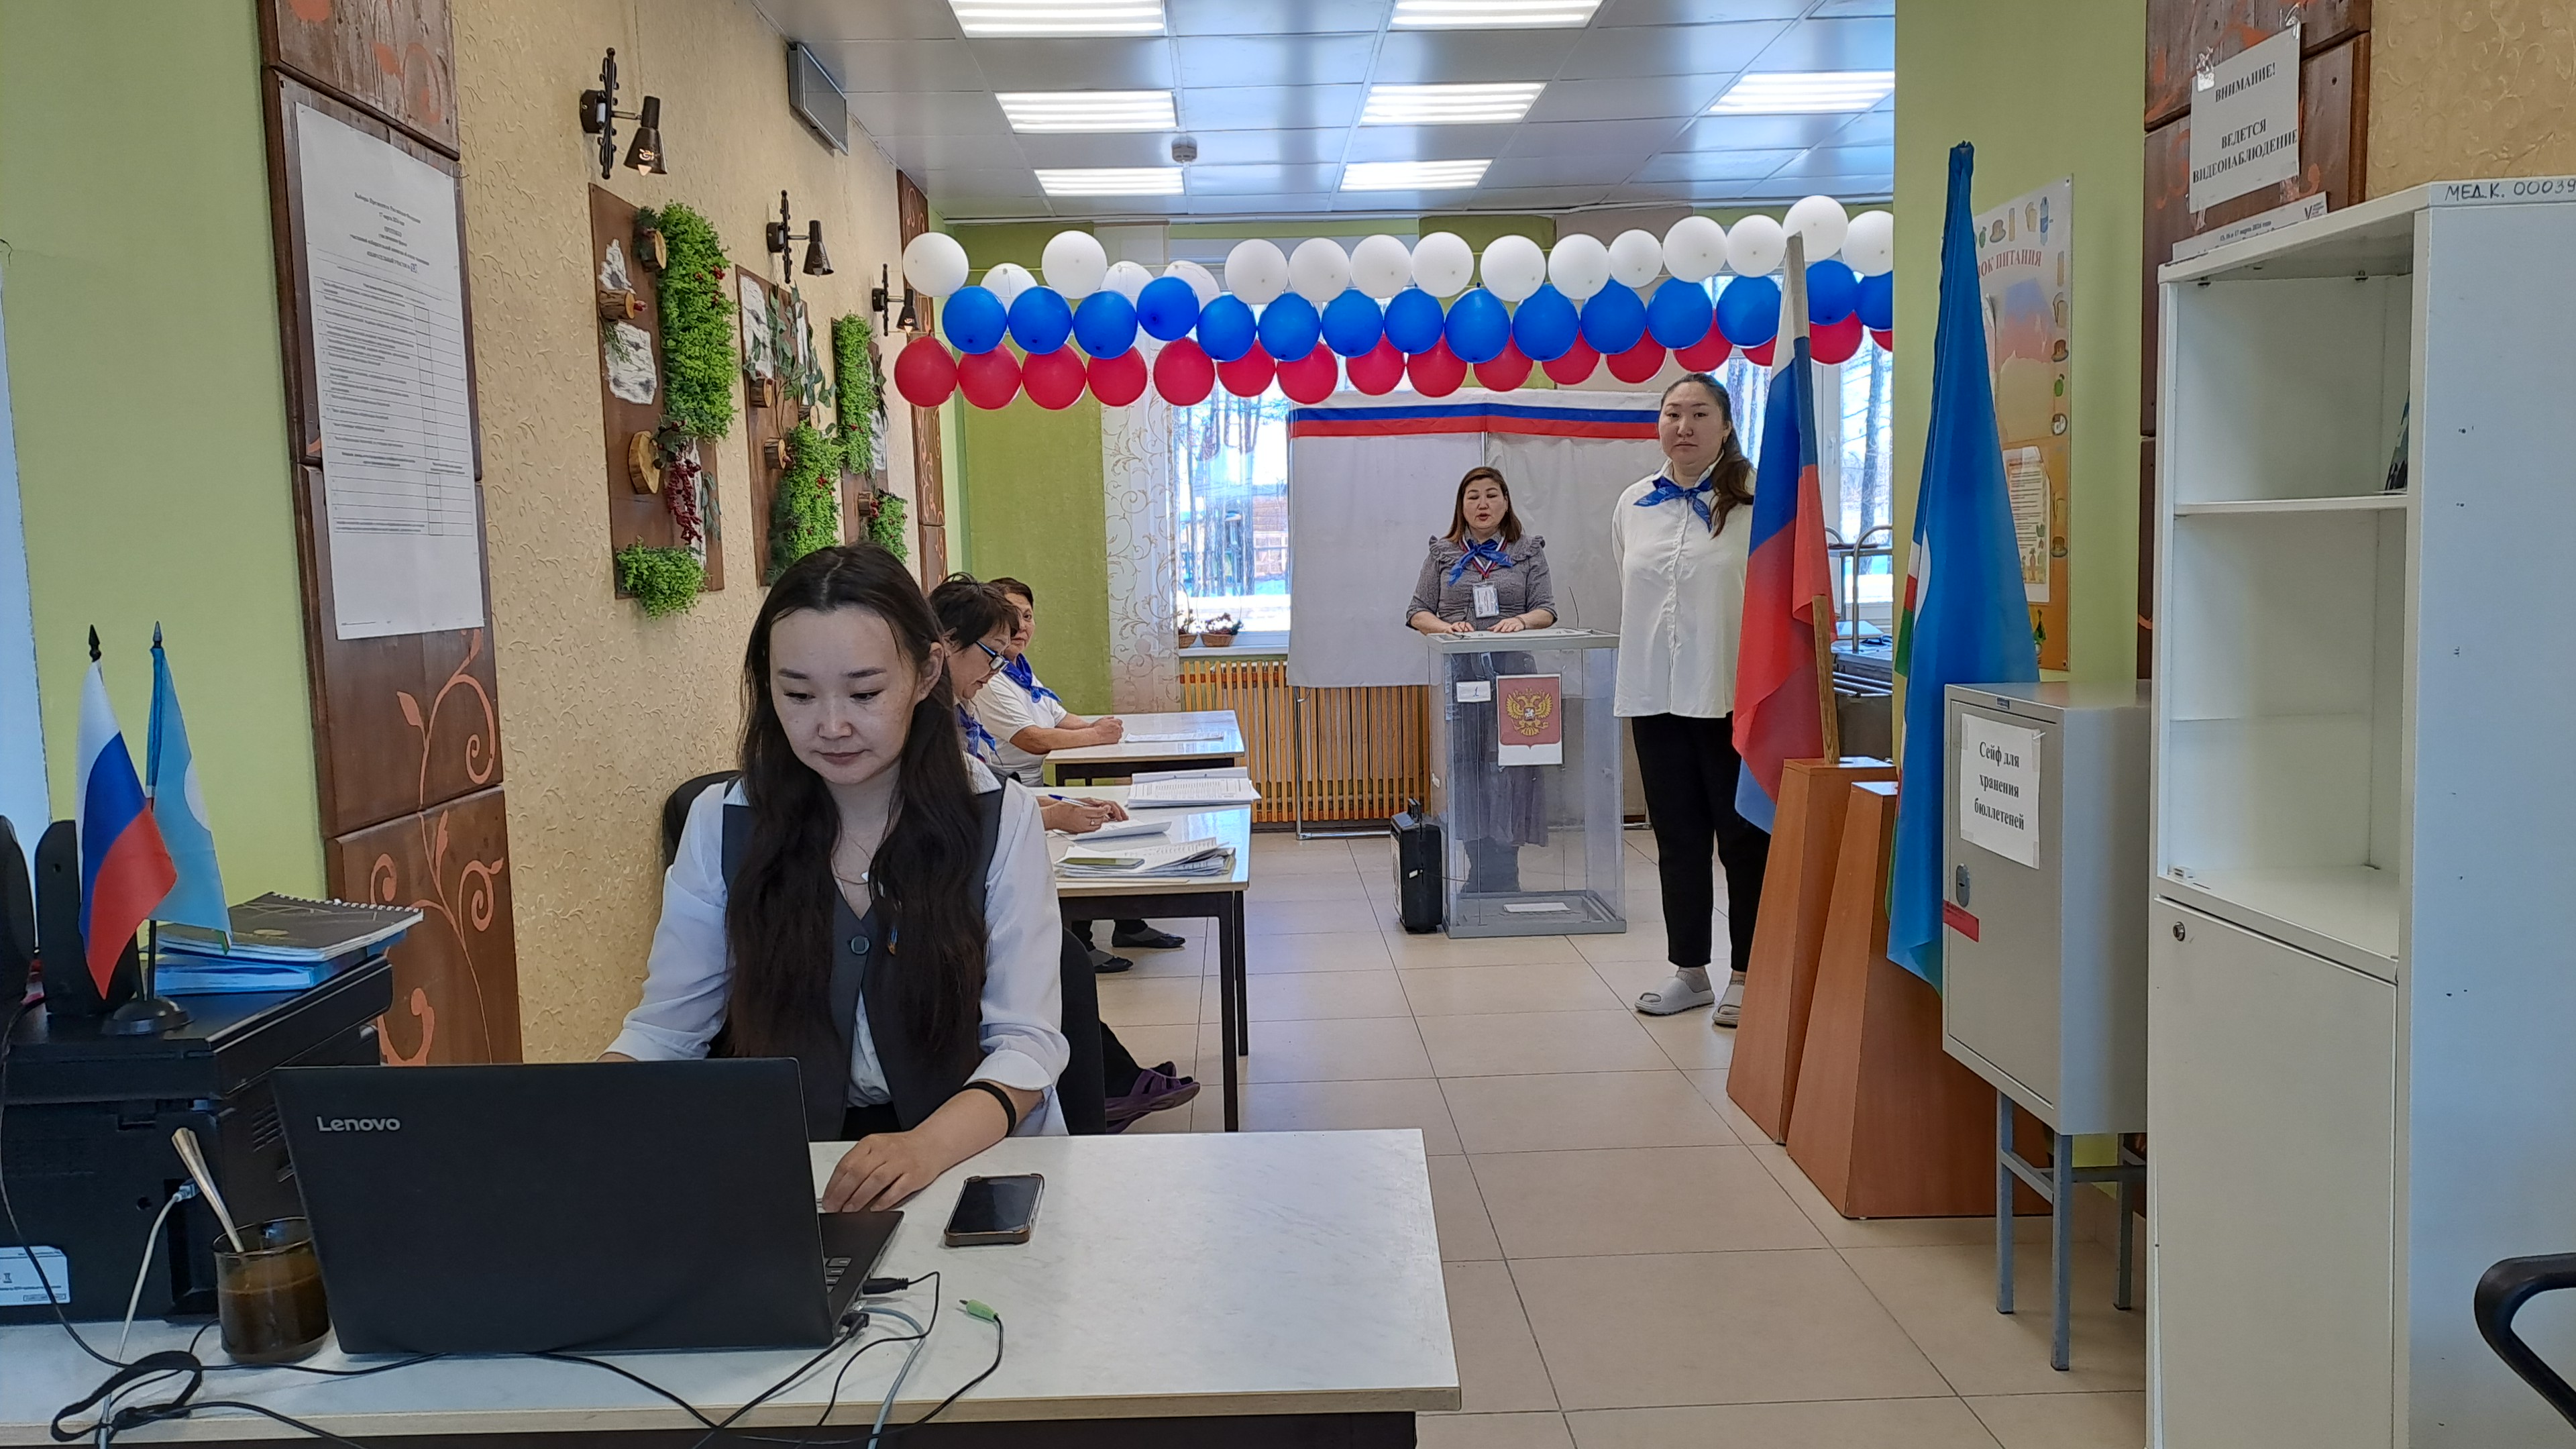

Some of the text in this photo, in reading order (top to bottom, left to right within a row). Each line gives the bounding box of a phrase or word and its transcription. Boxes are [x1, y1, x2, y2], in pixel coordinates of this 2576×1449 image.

[2215, 62, 2275, 102] ВНИМАНИЕ!
[2221, 119, 2266, 149] ВЕДЕТСЯ
[2193, 129, 2298, 183] ВИДЕОНАБЛЮДЕНИЕ
[1996, 249, 2042, 270] ПИТАНИЯ
[1980, 741, 2019, 768] Сейф для
[1979, 773, 2019, 798] хранения
[1974, 797, 2024, 830] бюллетеней
[316, 1116, 401, 1132] Lenovo
